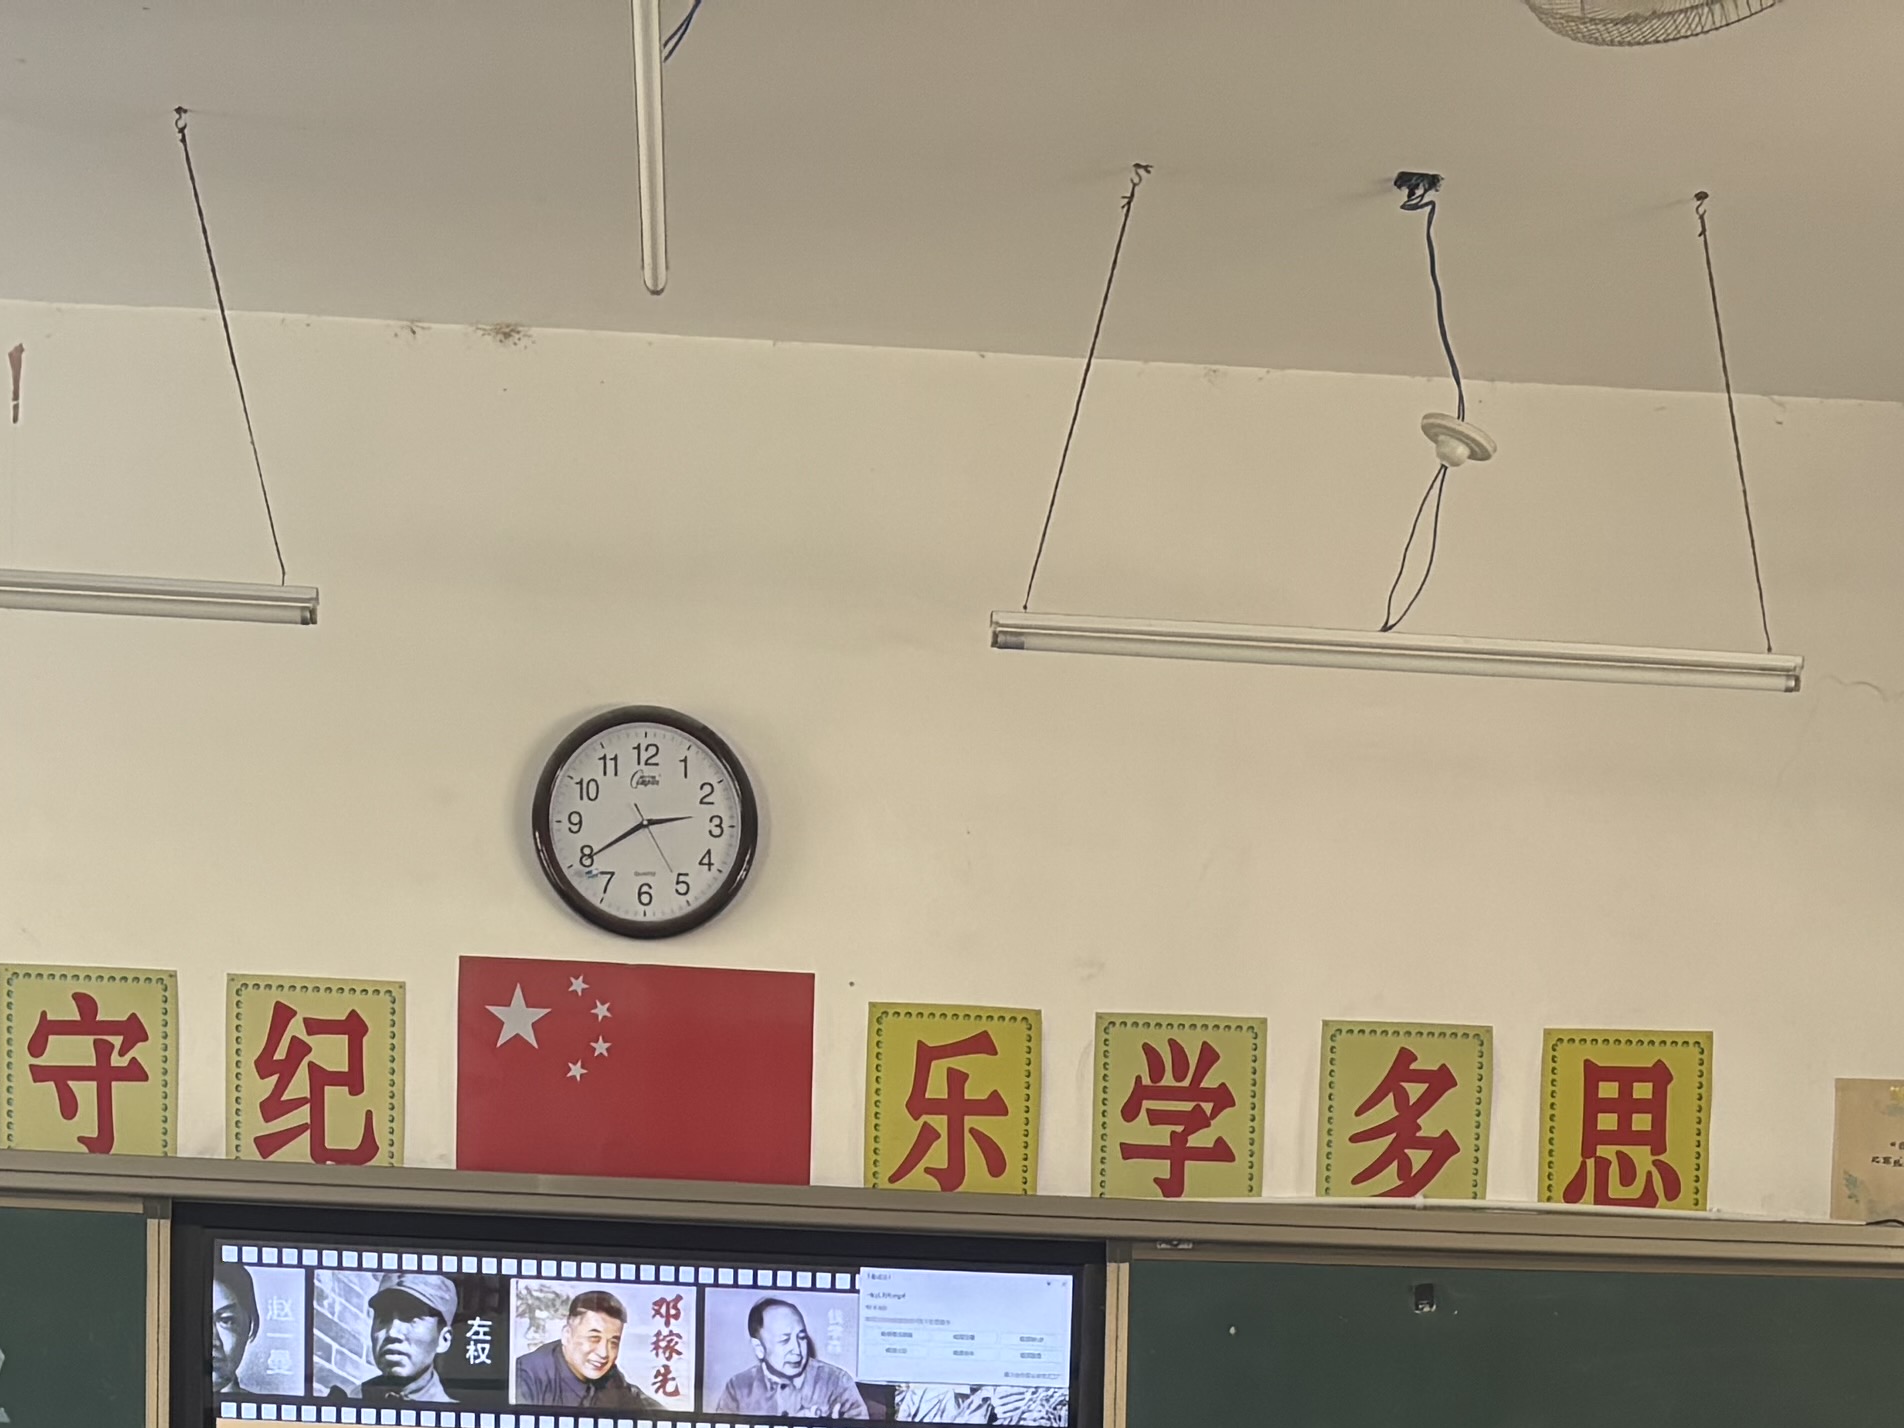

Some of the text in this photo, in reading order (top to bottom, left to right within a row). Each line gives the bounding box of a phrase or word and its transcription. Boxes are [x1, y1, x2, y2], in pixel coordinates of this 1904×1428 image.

[598, 753, 618, 777] 11
[632, 743, 660, 766] 12
[679, 755, 688, 779] 1
[574, 778, 600, 801] 10
[698, 782, 715, 805] 2
[567, 811, 583, 834] 9
[708, 815, 724, 838] 3
[579, 845, 594, 868] 8
[698, 848, 715, 872] 4
[599, 871, 615, 894] 7
[675, 873, 690, 896] 5
[637, 883, 653, 906] 6
[887, 1030, 1684, 1210] 乐学多思
[466, 1316, 492, 1365] 左权
[650, 1293, 684, 1398] 邓稼先
